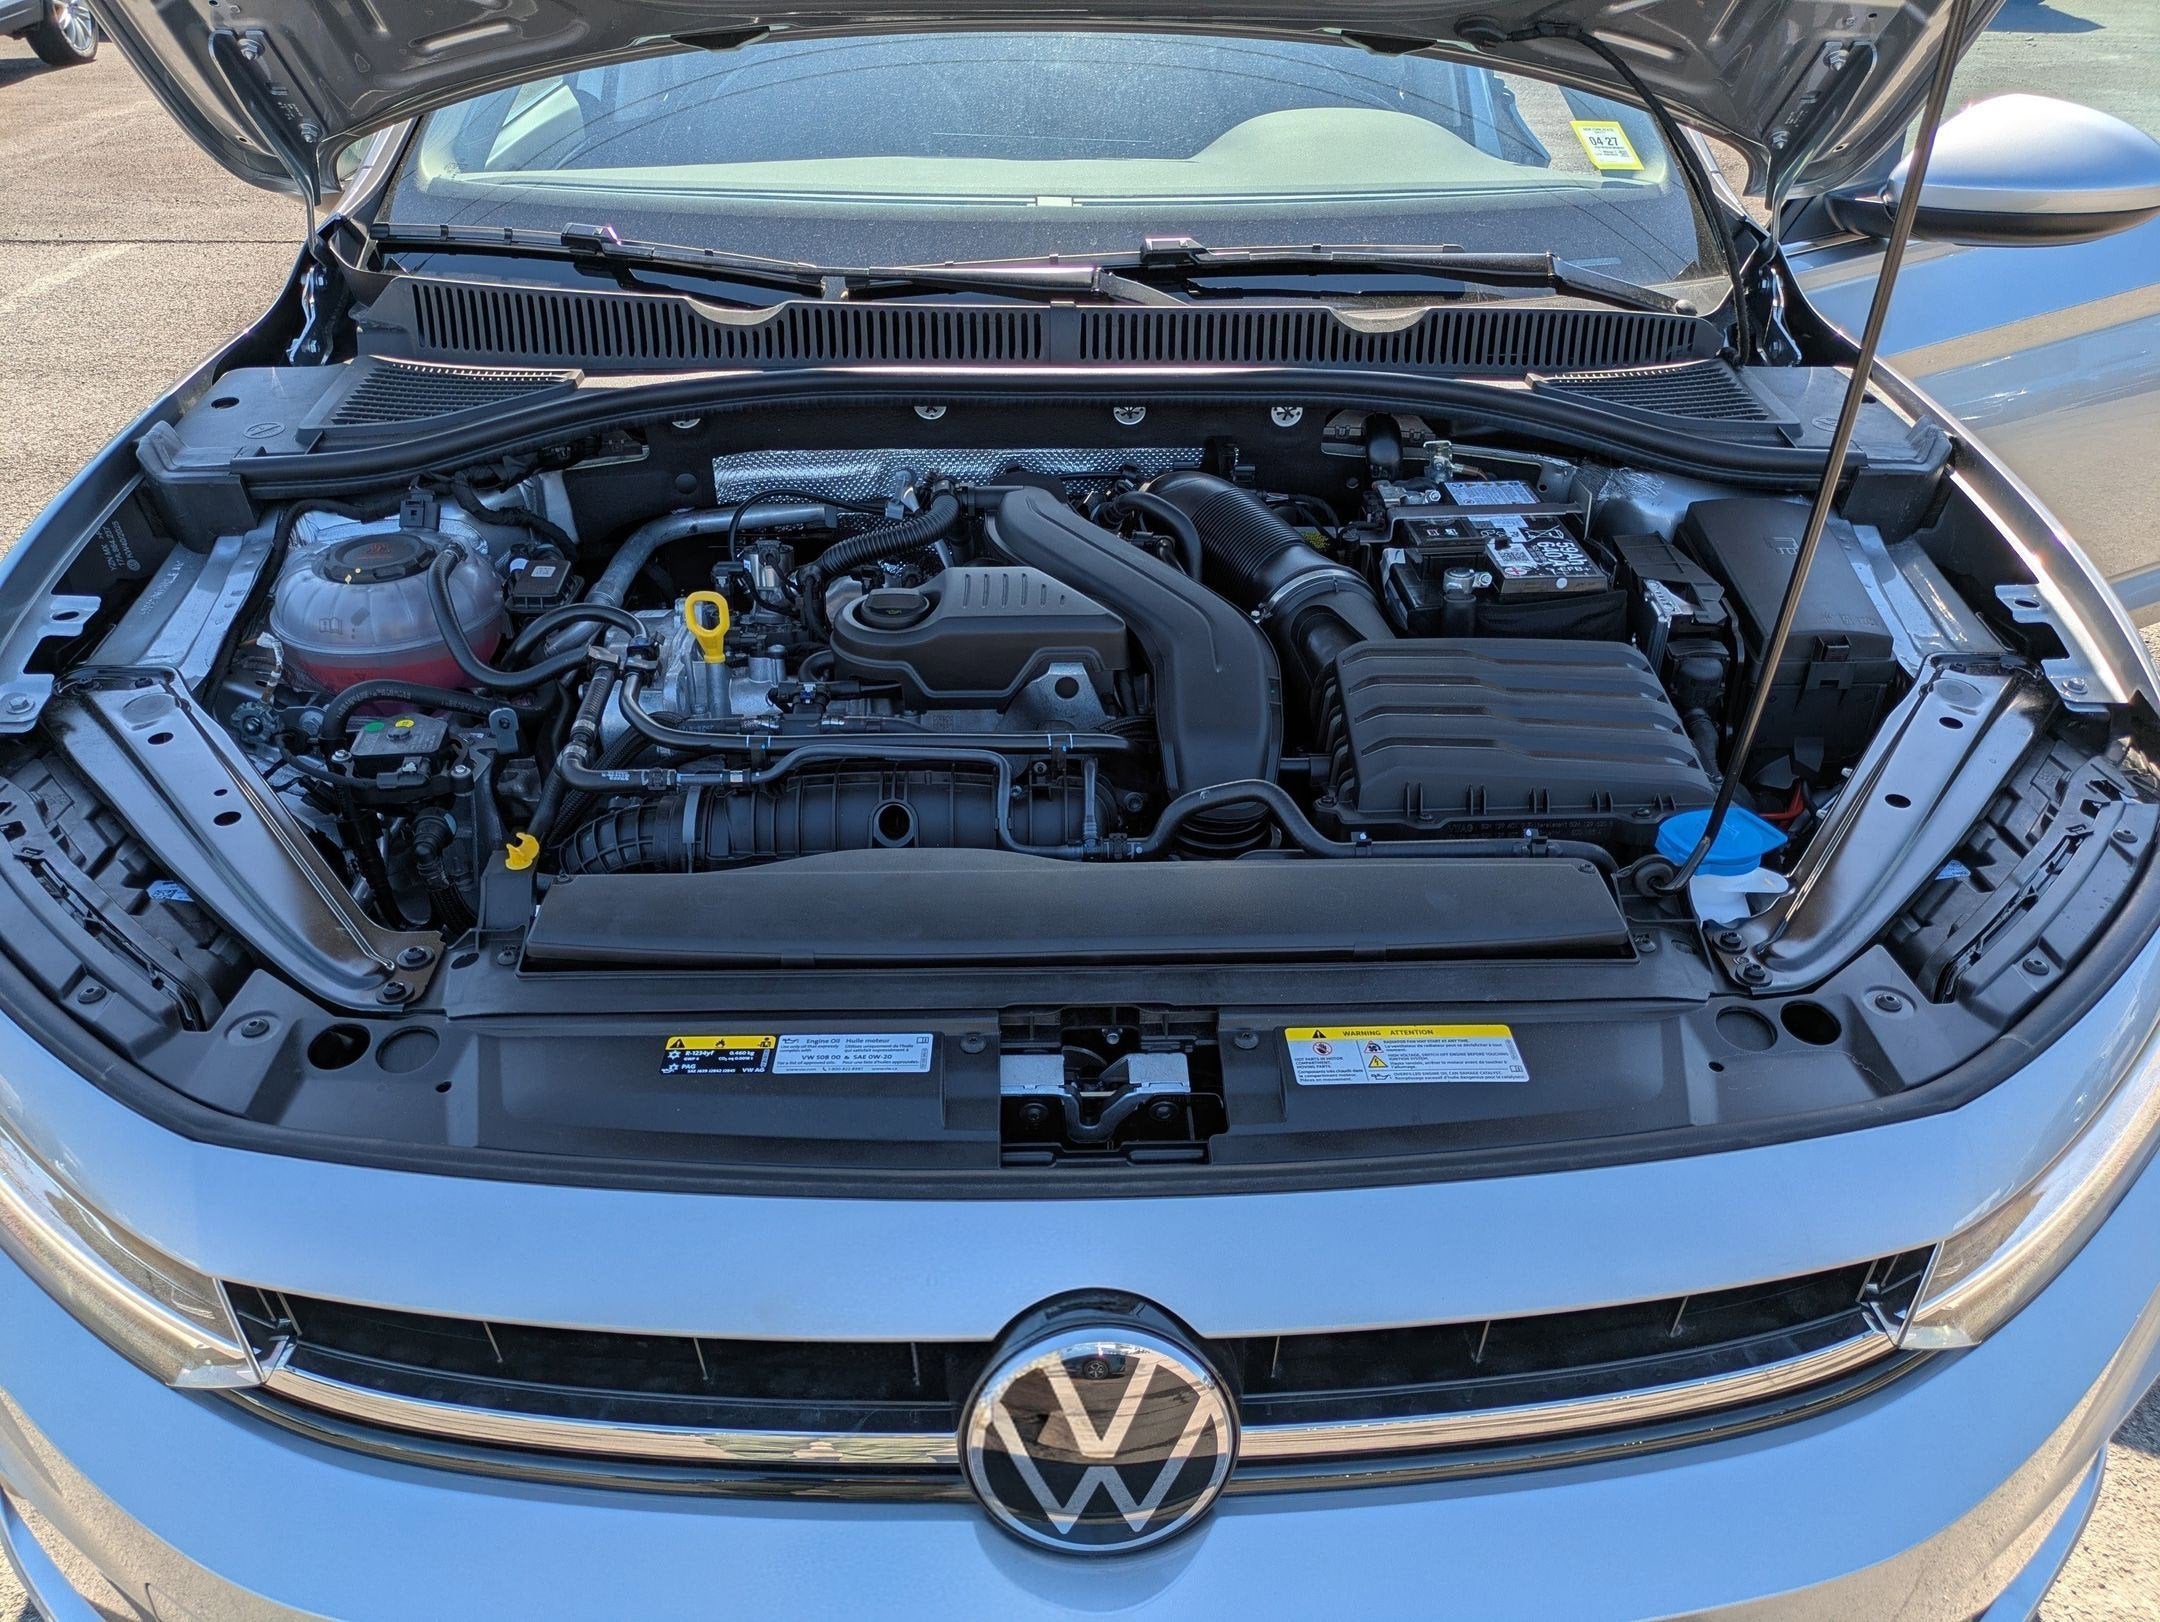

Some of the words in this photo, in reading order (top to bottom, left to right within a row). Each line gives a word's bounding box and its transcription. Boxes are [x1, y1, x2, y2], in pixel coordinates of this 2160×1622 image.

[1589, 137, 1604, 145] 04
[1605, 137, 1618, 146] 27
[1556, 542, 1588, 566] 59Ah
